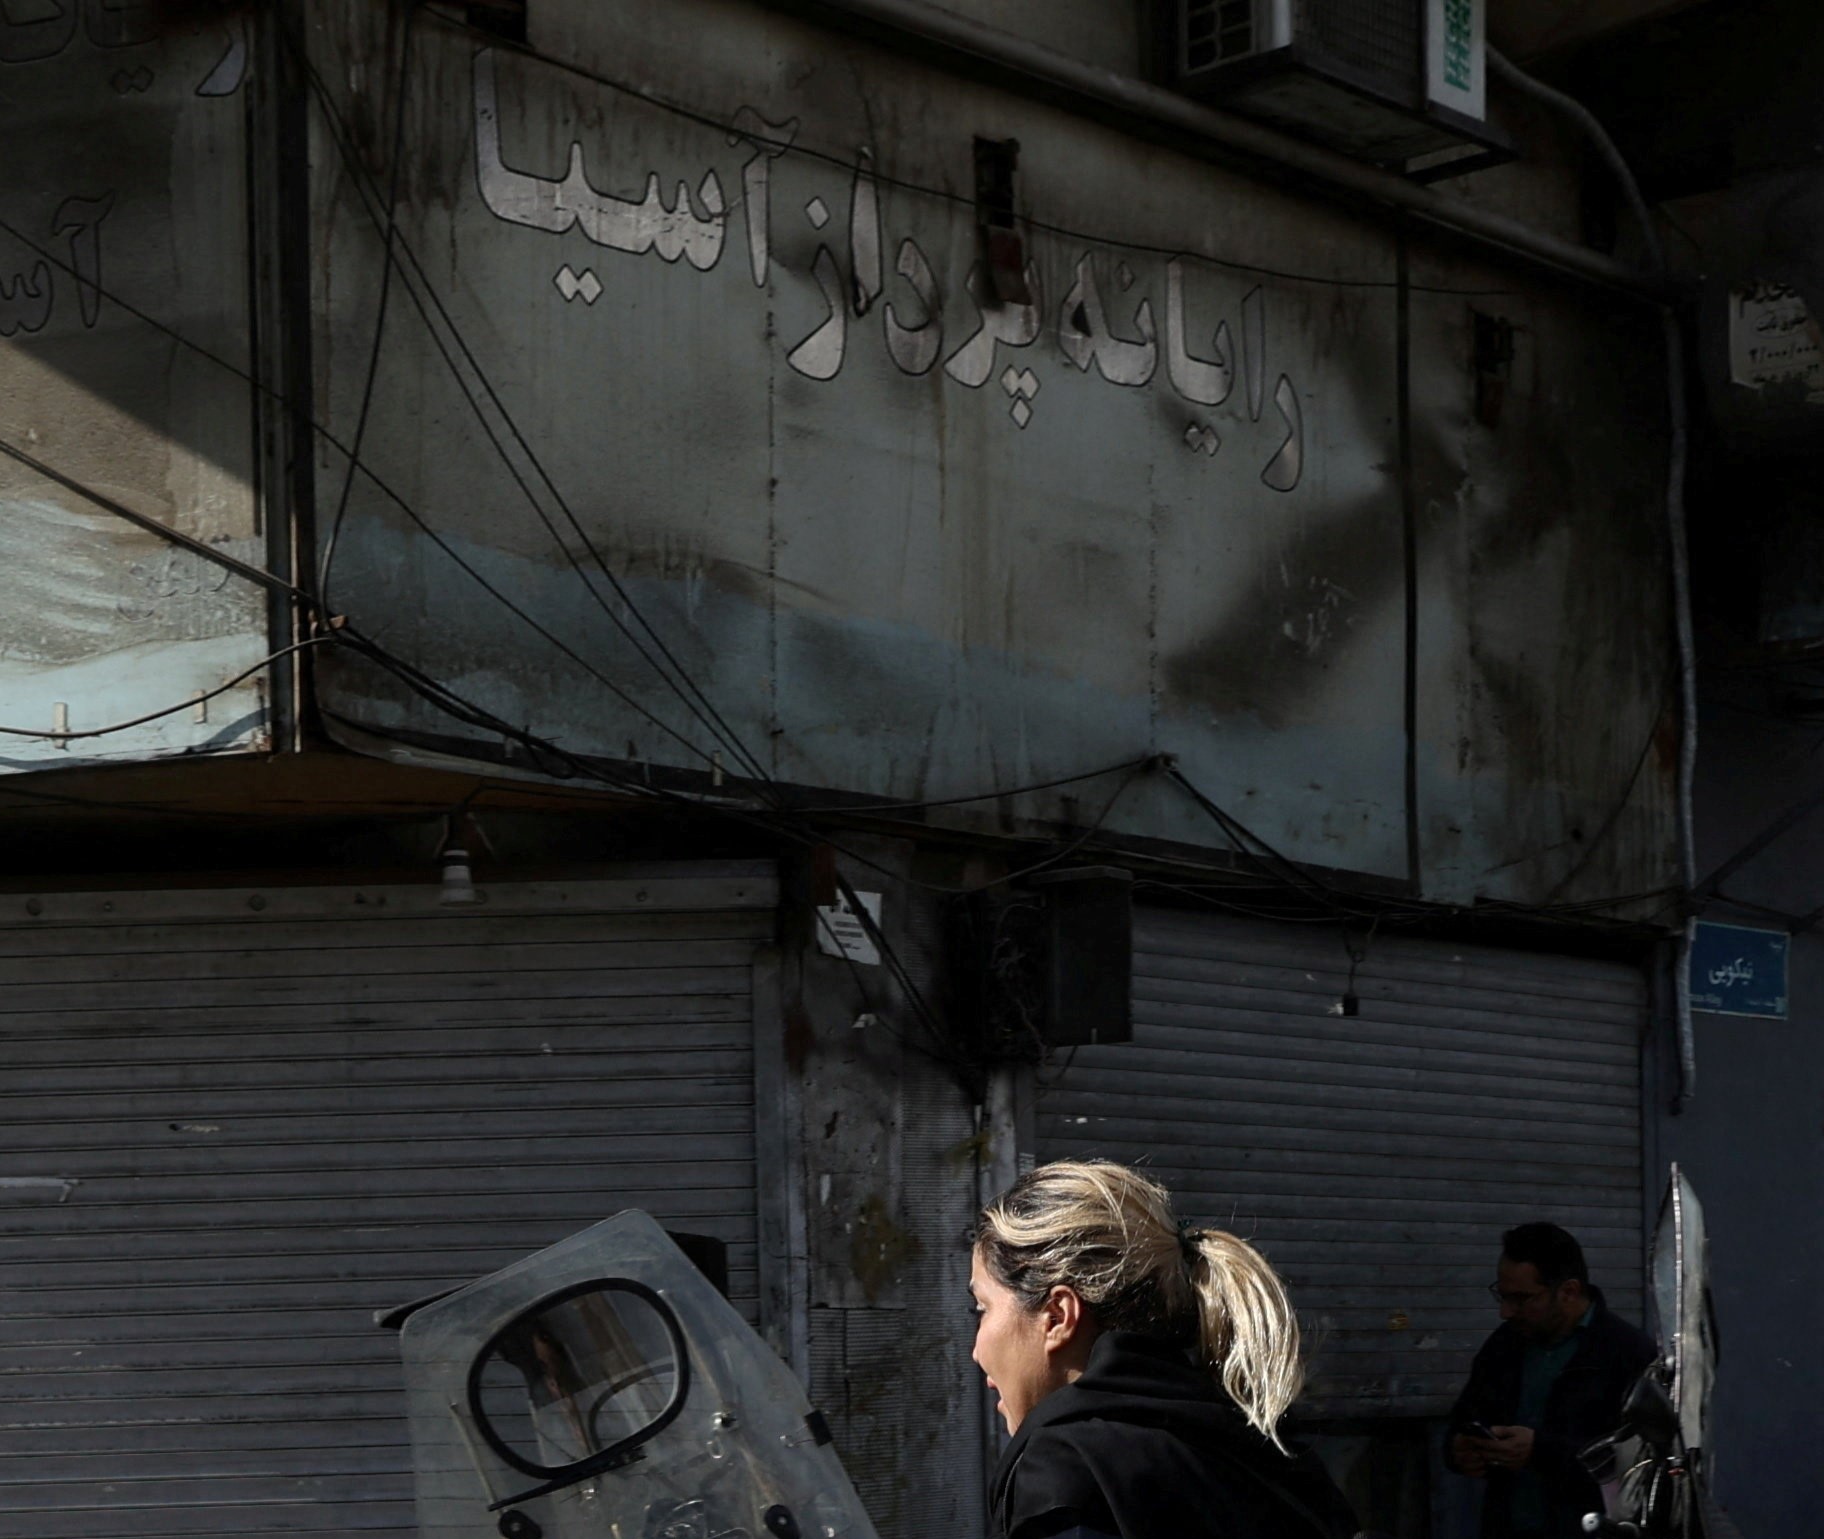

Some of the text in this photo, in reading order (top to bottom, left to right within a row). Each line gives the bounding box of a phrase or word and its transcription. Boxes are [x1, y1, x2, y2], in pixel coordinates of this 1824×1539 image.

[472, 46, 1305, 492] رایانه پرداز آسیا
